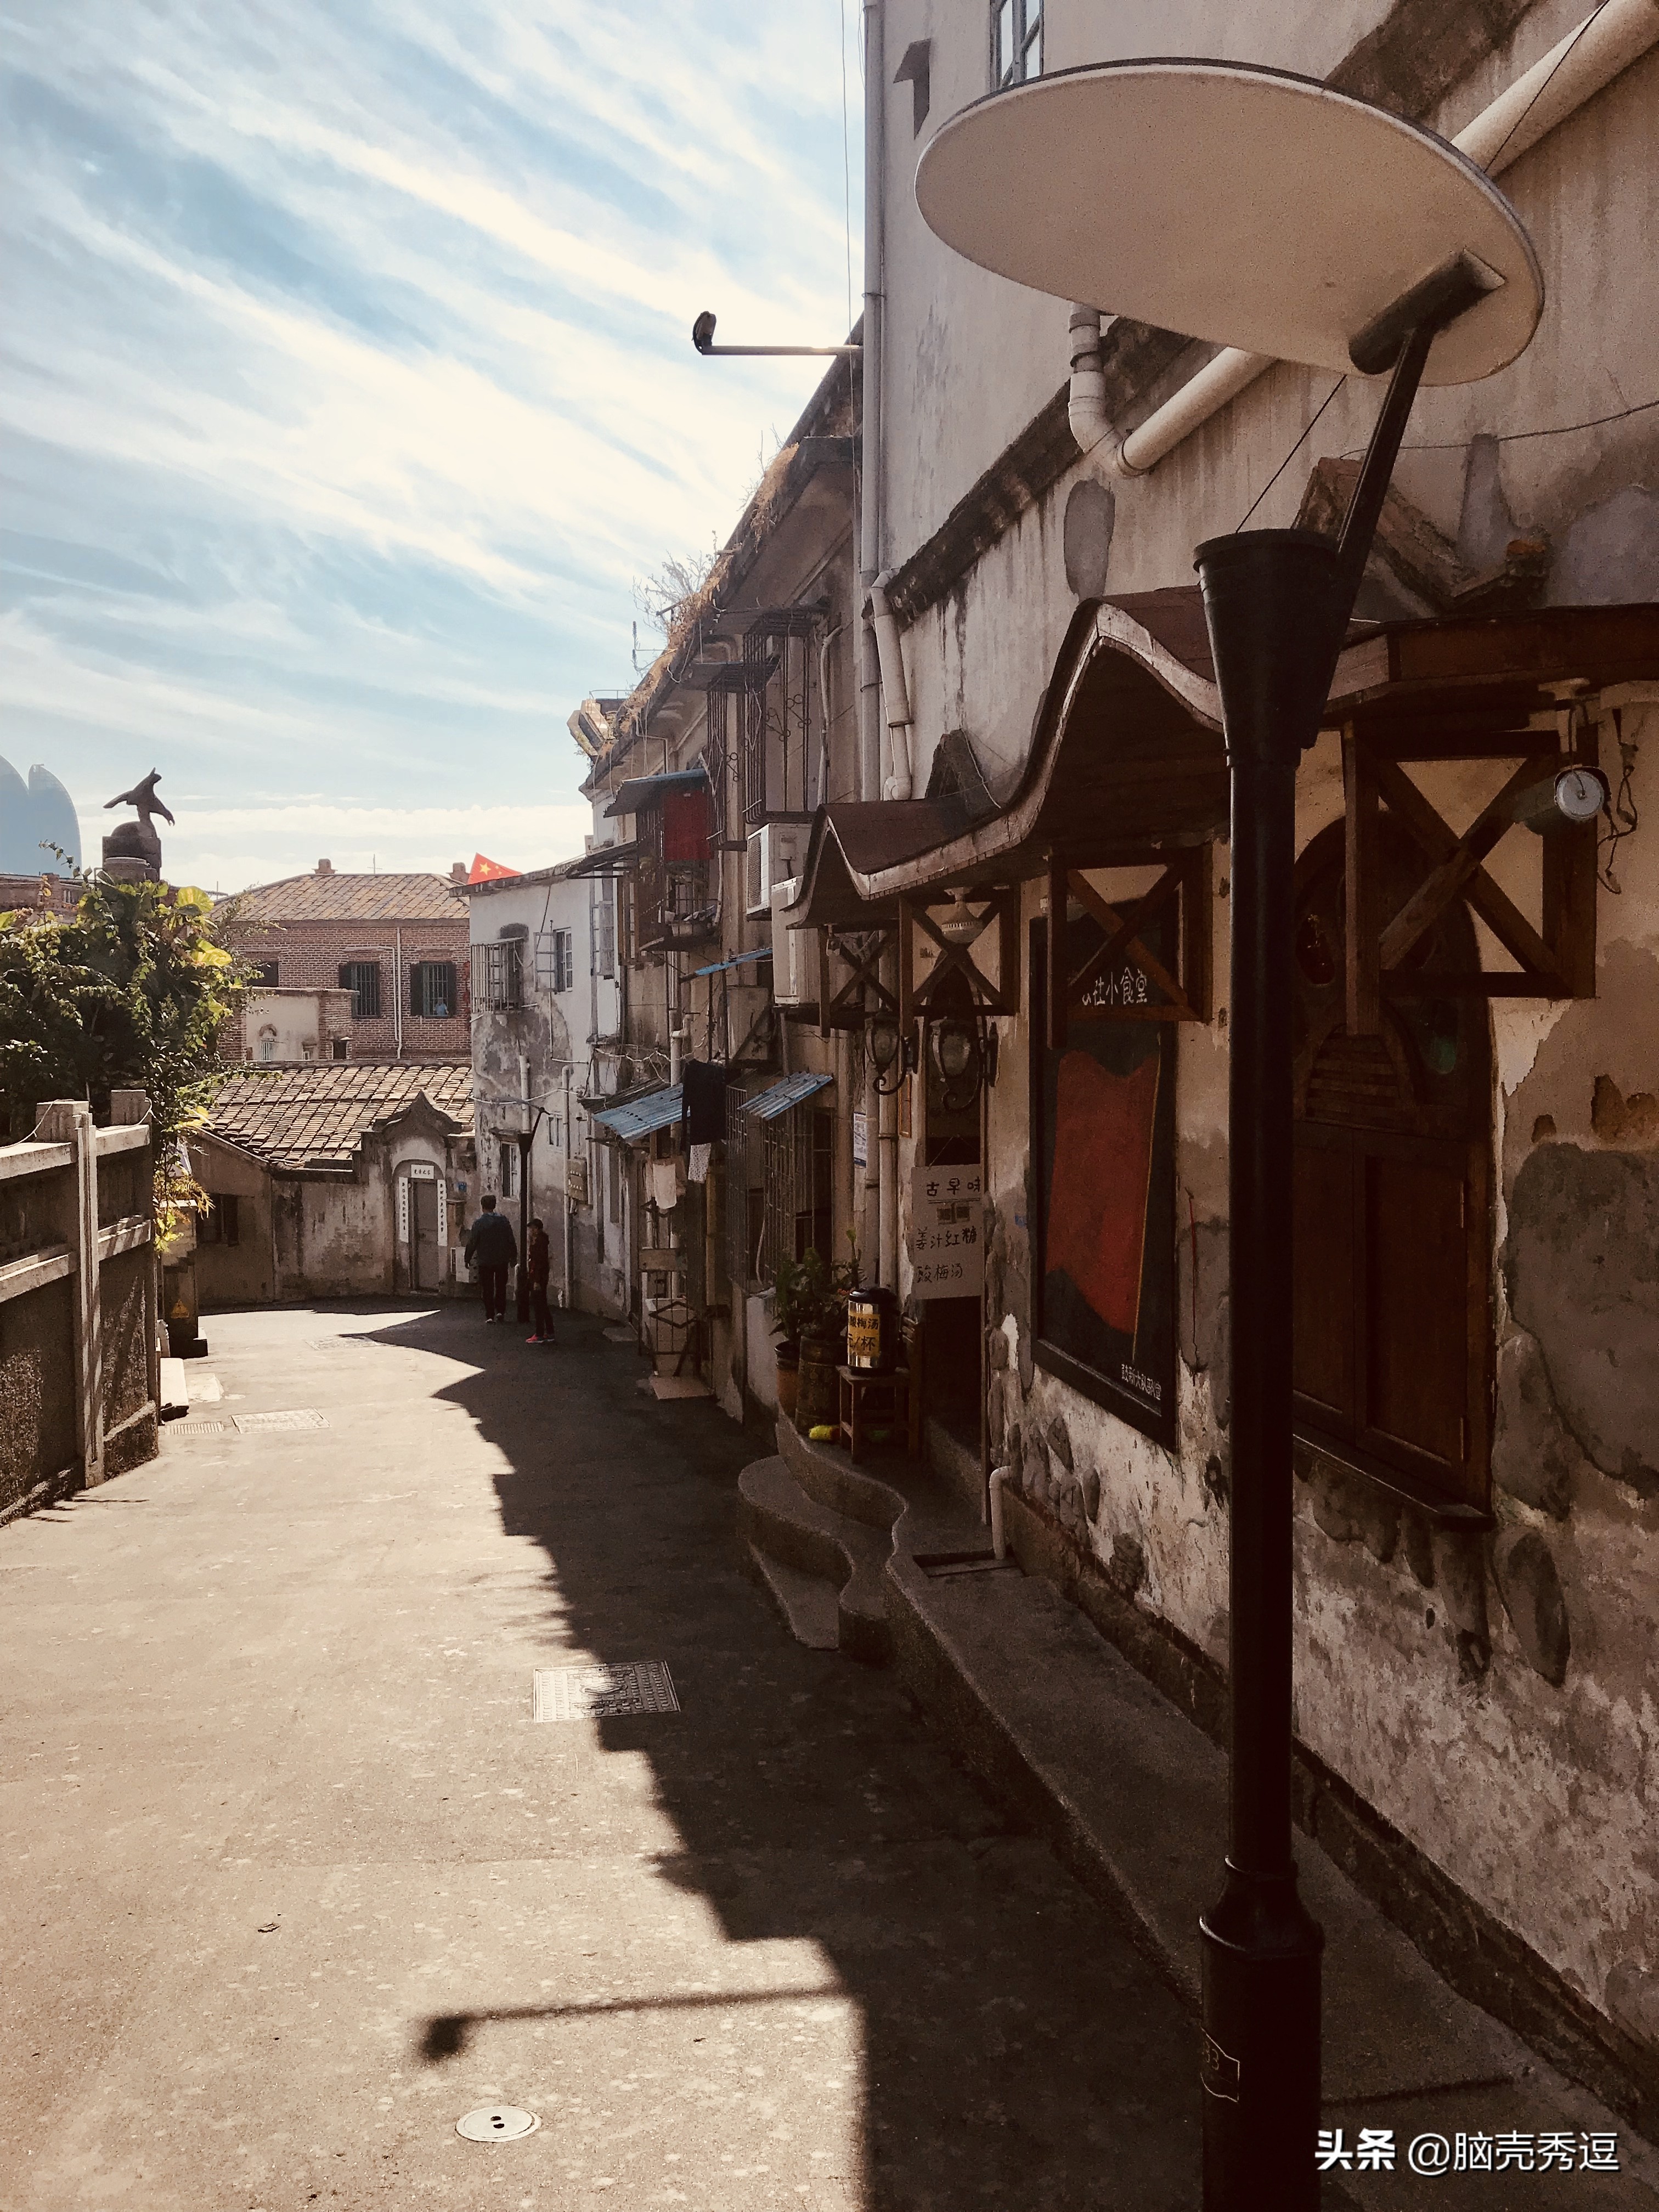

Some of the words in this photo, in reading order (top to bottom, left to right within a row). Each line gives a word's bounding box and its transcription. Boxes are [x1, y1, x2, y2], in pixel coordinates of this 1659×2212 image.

[926, 1176, 980, 1197] 古早味
[916, 1226, 977, 1251] 姜汁红糖
[916, 1263, 963, 1283] 酸梅汤
